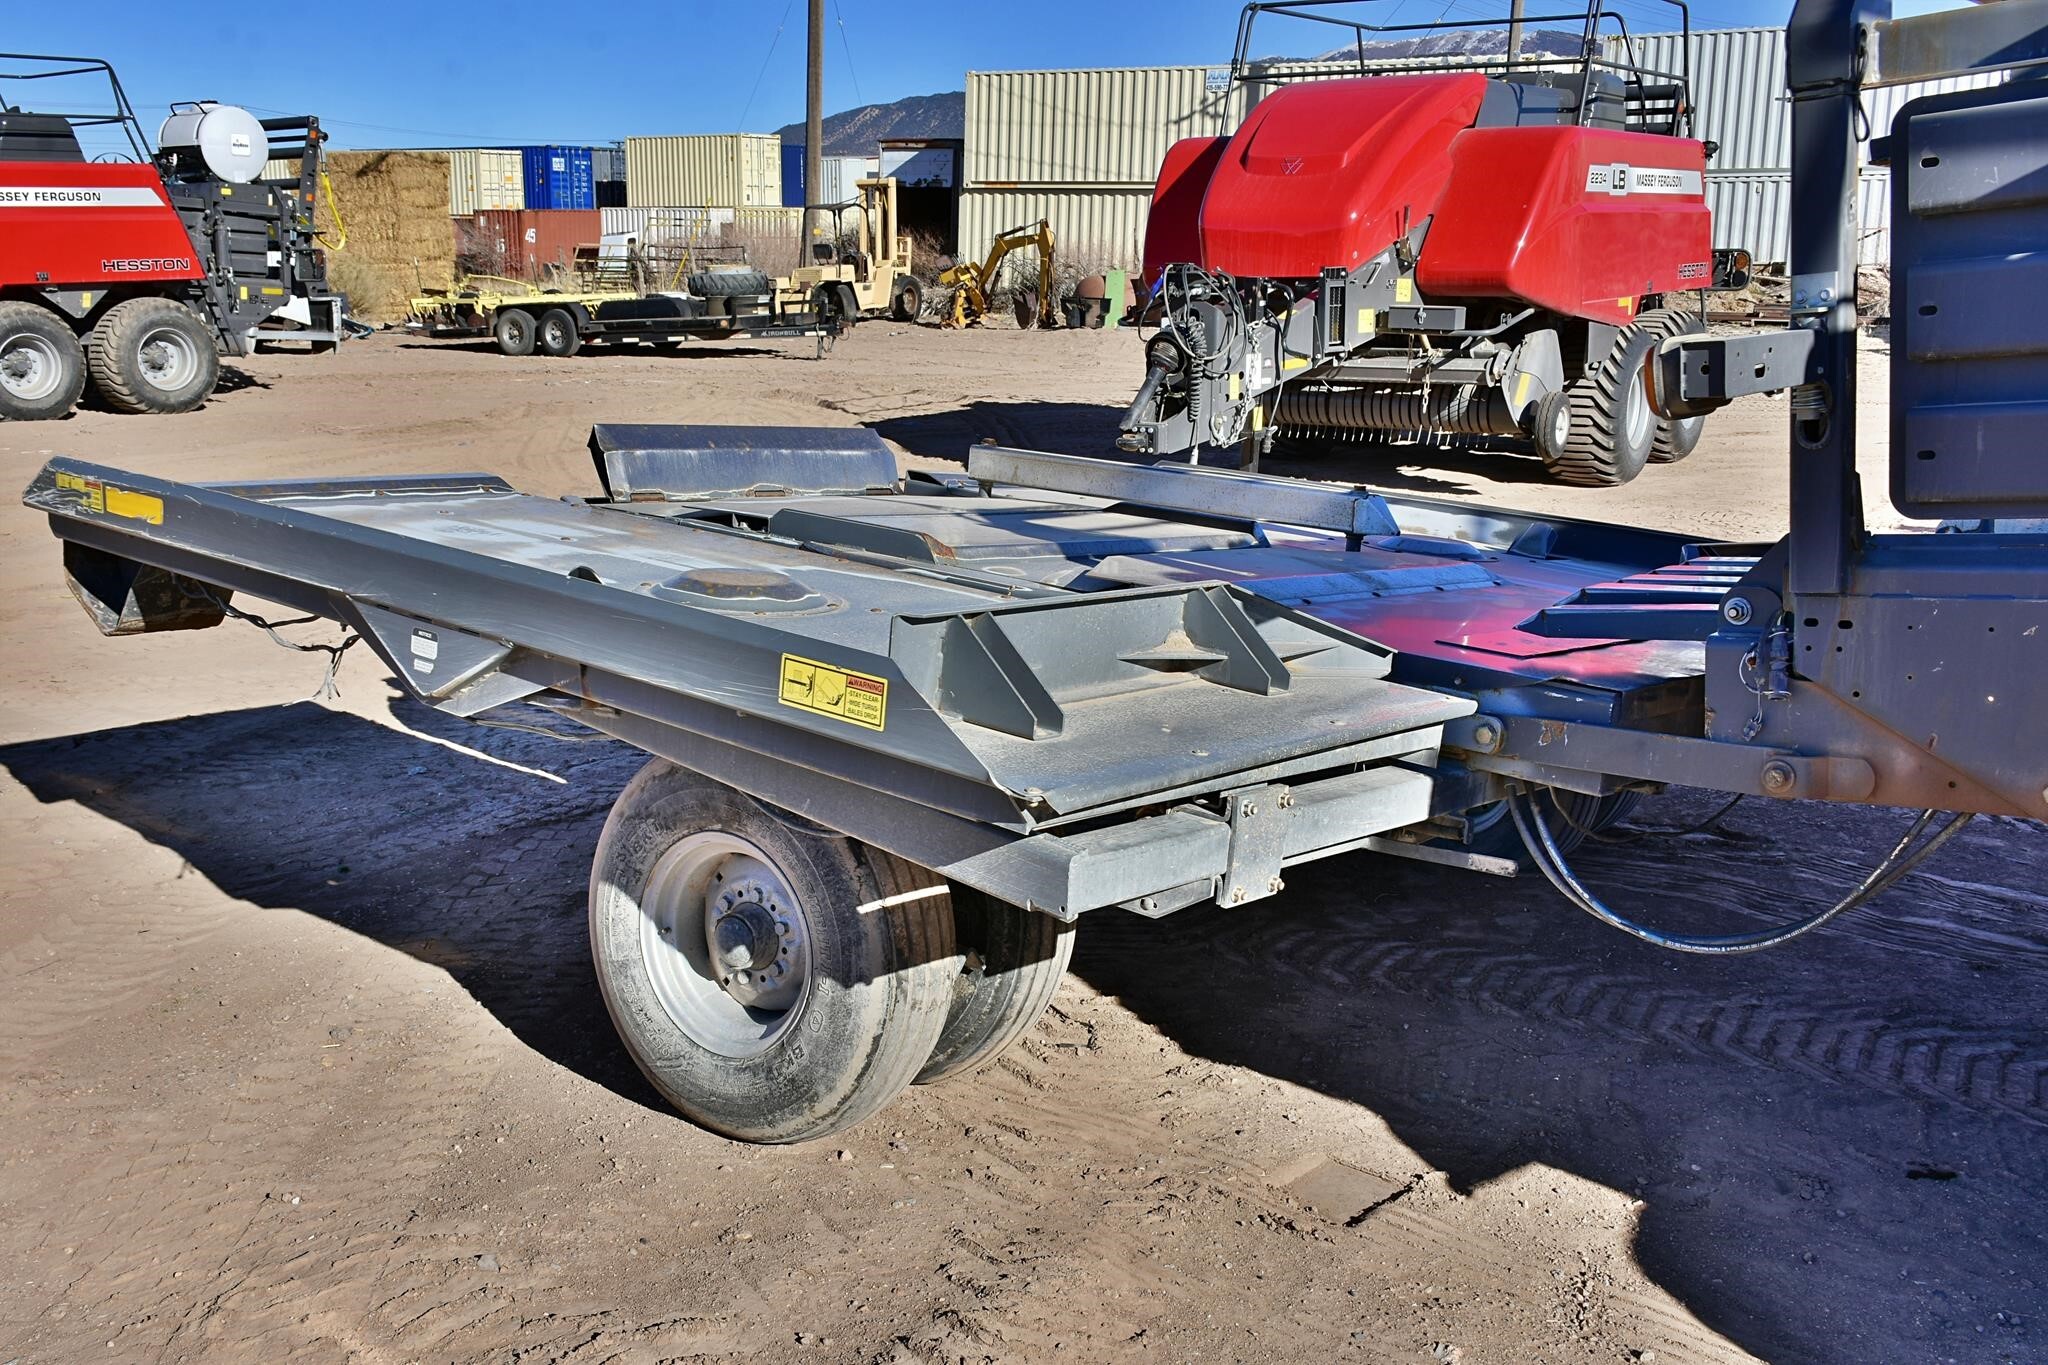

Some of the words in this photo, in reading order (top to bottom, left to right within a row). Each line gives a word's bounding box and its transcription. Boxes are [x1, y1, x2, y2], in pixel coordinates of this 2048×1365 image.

[1590, 172, 1607, 184] 2234
[1612, 169, 1626, 190] LB
[1636, 173, 1657, 187] MASSEY
[1658, 174, 1683, 188] FERGUSON
[34, 192, 101, 202] FERGUSON
[102, 258, 190, 272] HESSTON
[1678, 262, 1708, 279] HESSTON
[853, 679, 882, 693] WARNING
